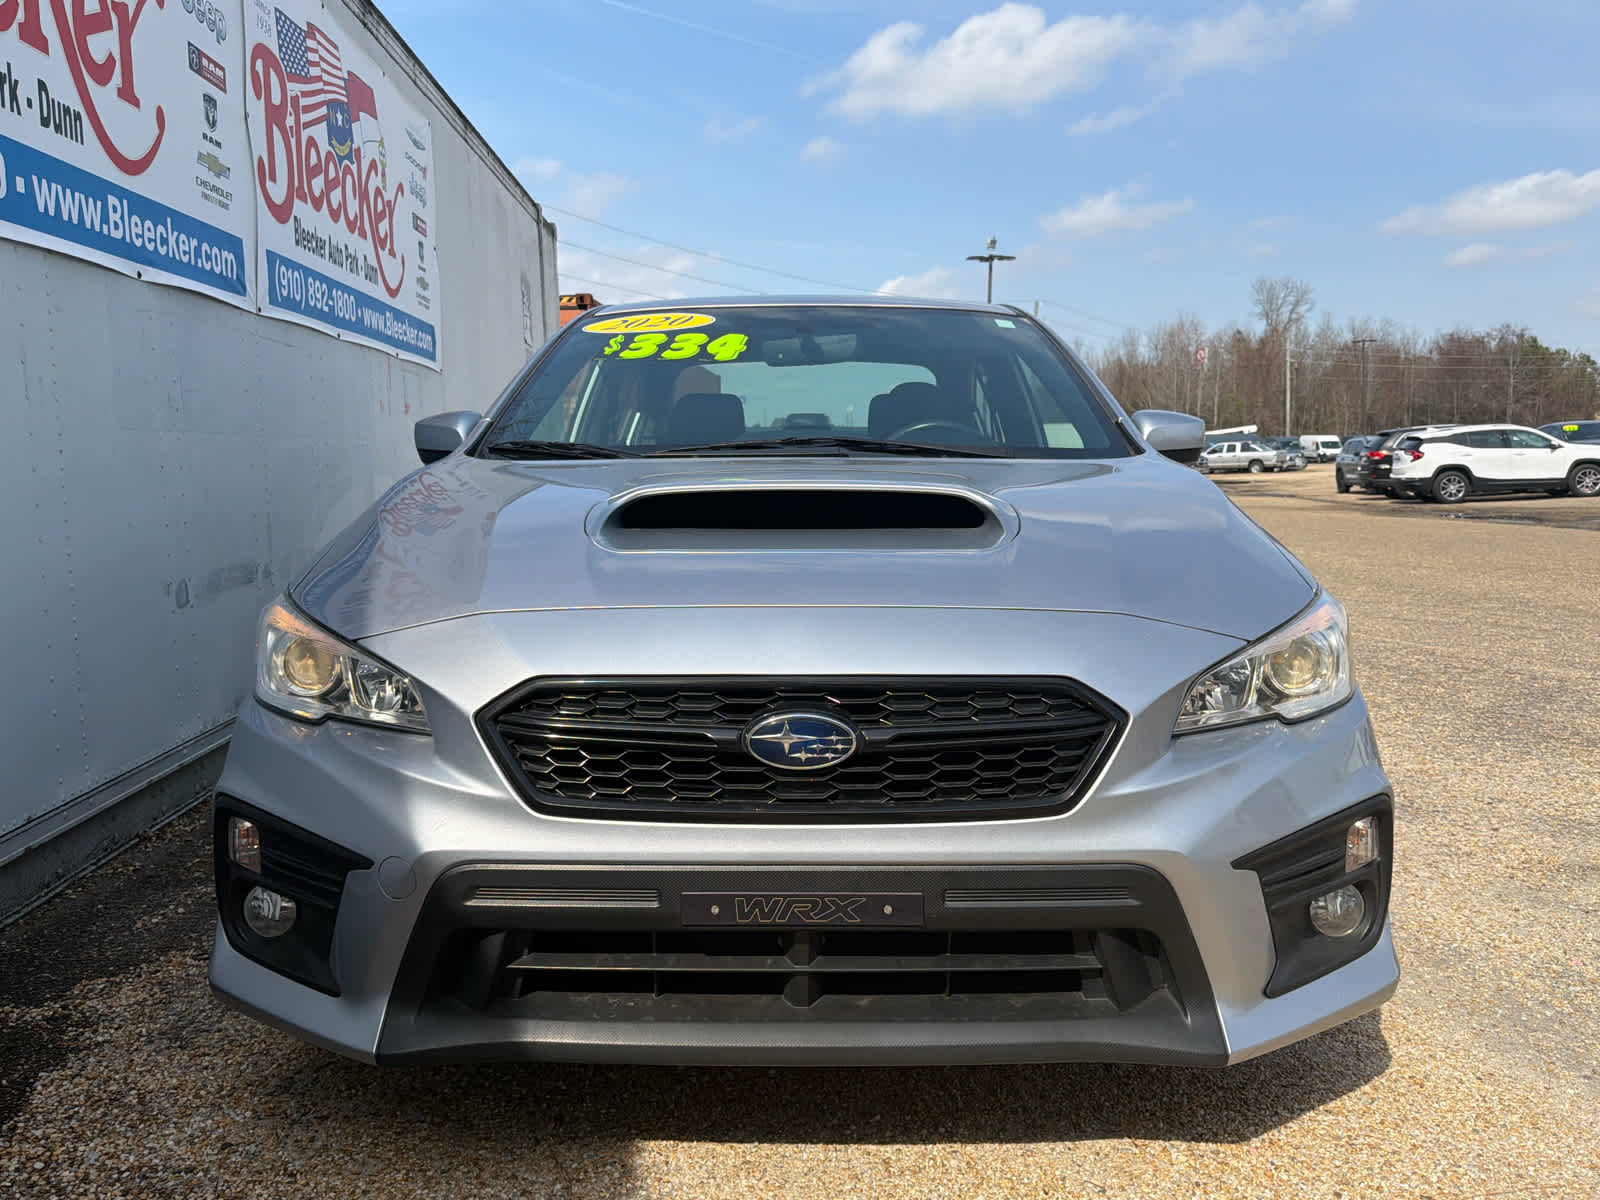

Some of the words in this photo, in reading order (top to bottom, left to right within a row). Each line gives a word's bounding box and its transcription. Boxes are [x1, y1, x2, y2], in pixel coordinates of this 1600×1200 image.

[37, 78, 84, 146] Dunn
[202, 132, 222, 149] RAM
[195, 175, 233, 203] CHEVROLET
[250, 43, 405, 299] Bleecker
[31, 174, 238, 280] www.Bleecker.com
[293, 215, 327, 261] Bleecker
[328, 234, 344, 269] Auto
[344, 243, 360, 277] Park
[363, 254, 379, 287] Dunn
[275, 258, 306, 311] (910)
[307, 277, 357, 322] 892-1800
[362, 306, 433, 353] www.Bleecker.com
[600, 315, 694, 331] 2020
[603, 333, 749, 361] $334
[734, 898, 867, 923] WRX
